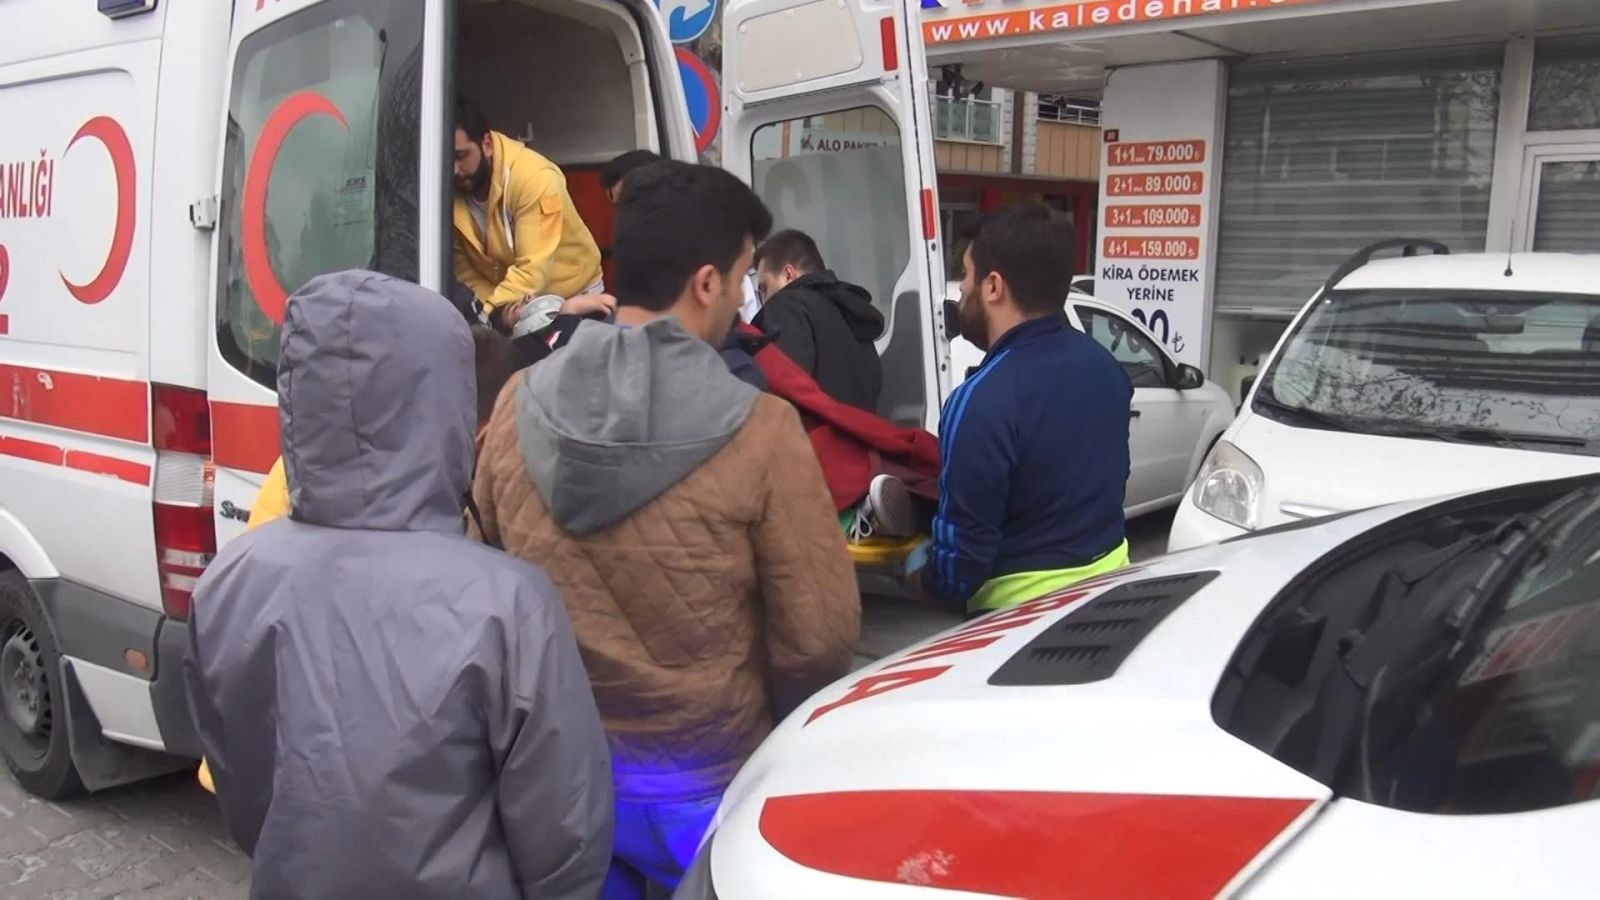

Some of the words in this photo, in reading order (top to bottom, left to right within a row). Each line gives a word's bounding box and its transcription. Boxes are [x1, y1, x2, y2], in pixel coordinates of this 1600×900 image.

[1114, 146, 1136, 163] 1+1
[1147, 144, 1194, 161] 79.000
[1113, 177, 1133, 193] 2+1
[1145, 175, 1191, 192] 89.000
[1112, 208, 1132, 224] 3+1
[1142, 208, 1189, 224] 109.000
[1108, 240, 1128, 256] 4+1
[1140, 240, 1187, 257] 159.000
[1102, 264, 1133, 280] KİRA
[1138, 264, 1199, 282] ÖDEMEK
[1126, 285, 1175, 301] YERİNE
